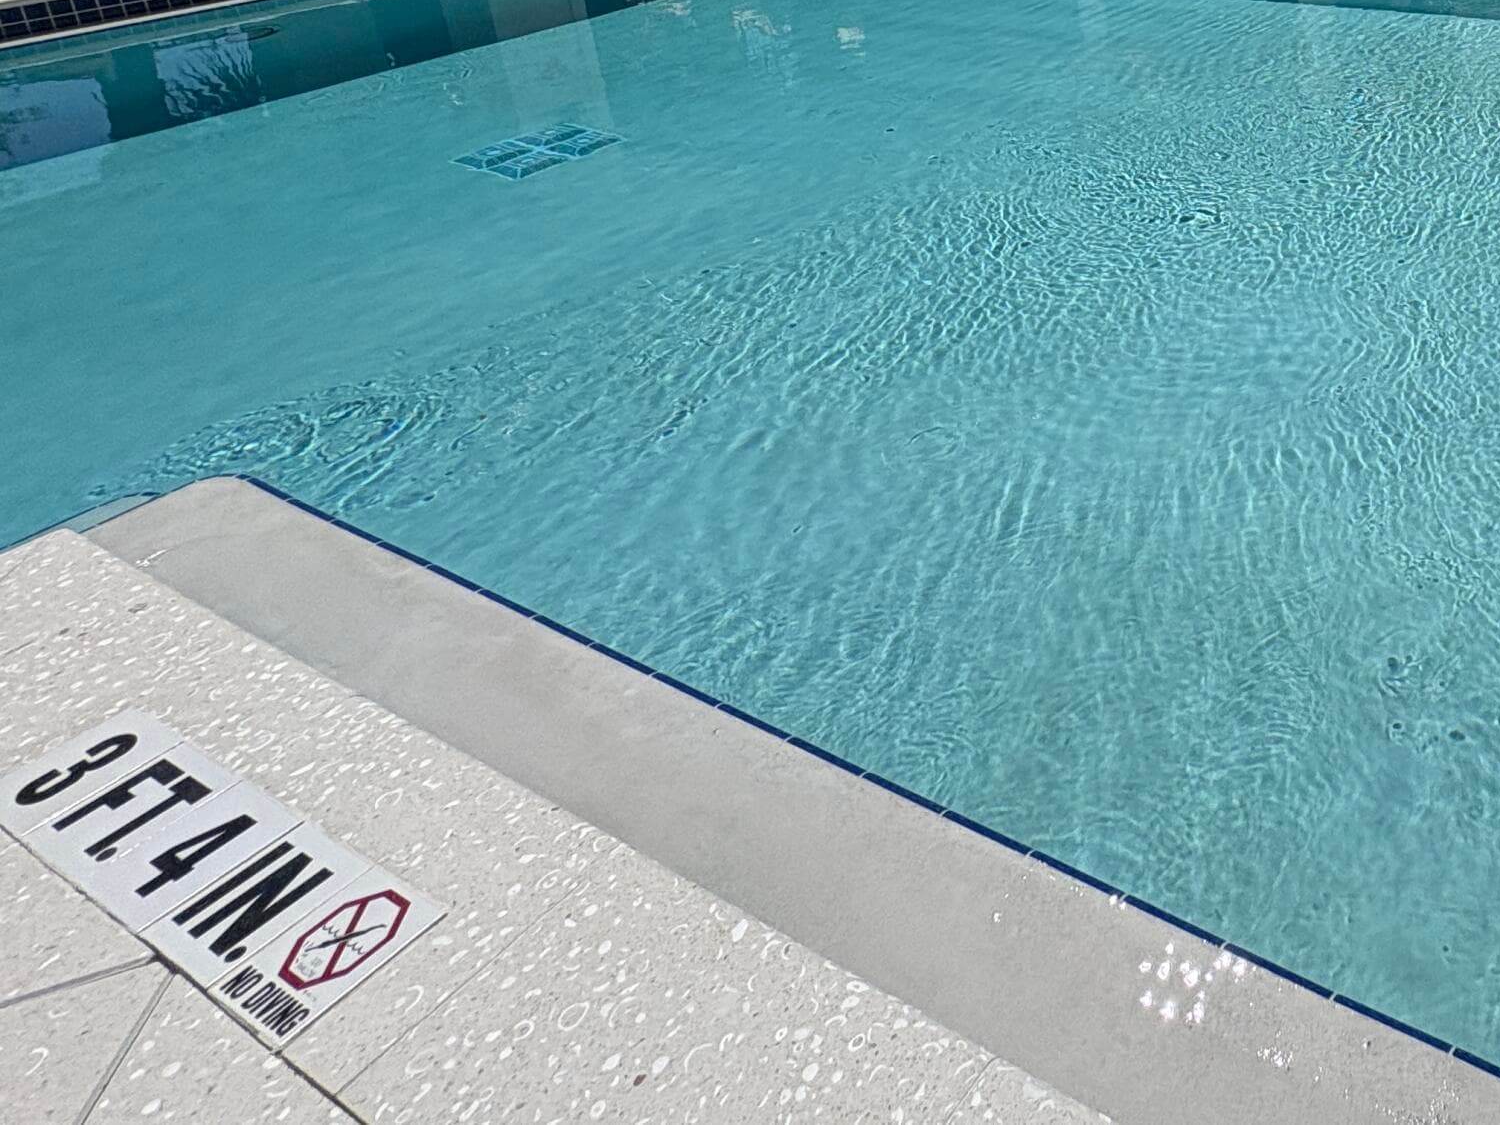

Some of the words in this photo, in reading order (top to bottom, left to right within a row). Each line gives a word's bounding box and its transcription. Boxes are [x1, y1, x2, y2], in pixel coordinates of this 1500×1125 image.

[15, 733, 138, 806] 3
[51, 758, 213, 863] FT.
[134, 813, 258, 899] 4
[171, 840, 335, 963] IN.
[219, 964, 264, 1000] NO
[240, 980, 310, 1037] DIVING
